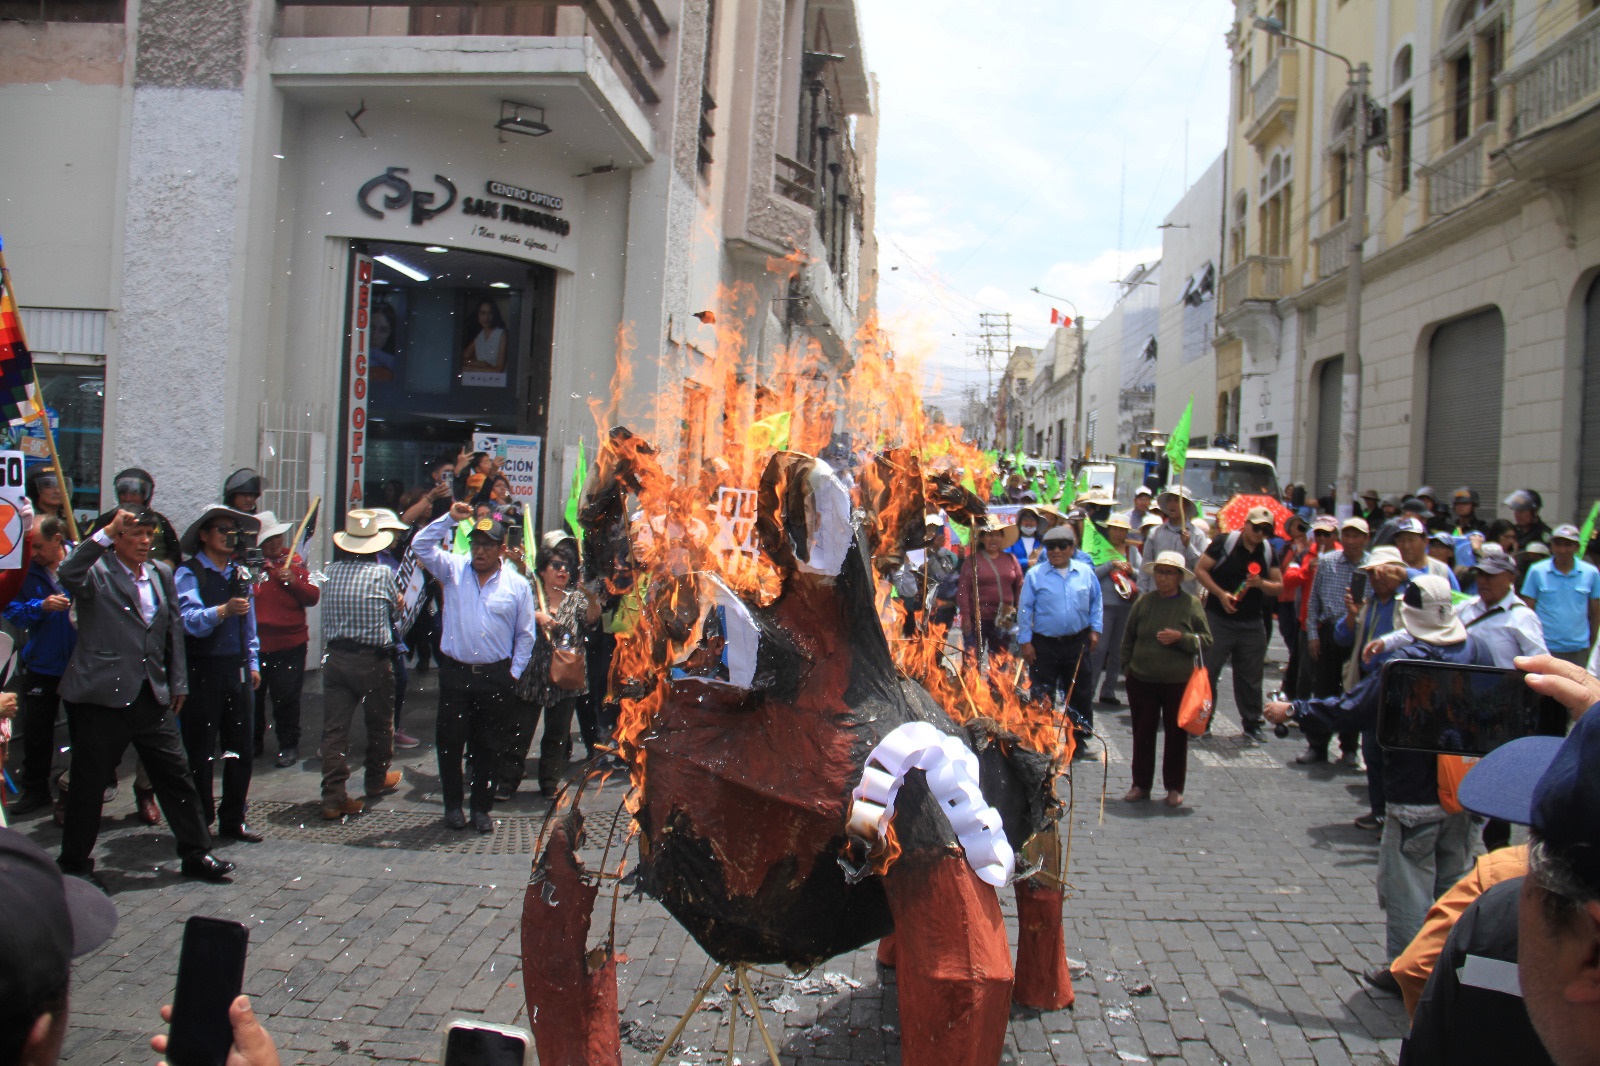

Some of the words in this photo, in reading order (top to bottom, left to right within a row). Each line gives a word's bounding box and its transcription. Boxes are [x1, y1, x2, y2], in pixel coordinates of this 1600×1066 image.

[462, 196, 499, 219] SAN
[490, 182, 528, 200] CENTRO
[529, 192, 562, 209] OPTICO
[355, 260, 372, 400] MEDICO
[518, 475, 533, 483] CON
